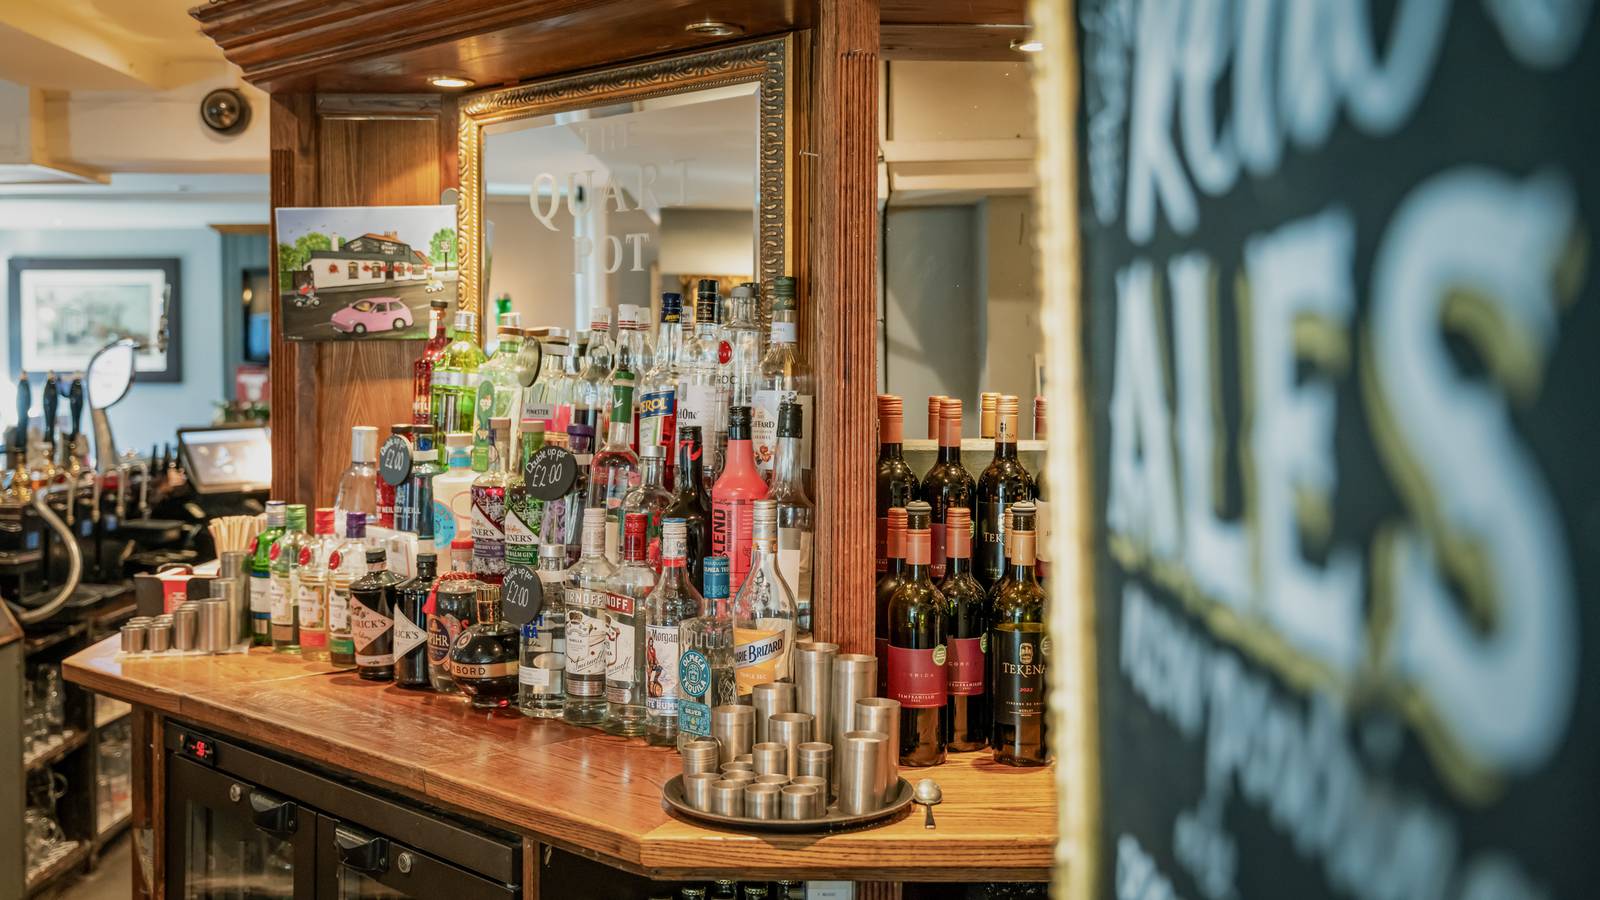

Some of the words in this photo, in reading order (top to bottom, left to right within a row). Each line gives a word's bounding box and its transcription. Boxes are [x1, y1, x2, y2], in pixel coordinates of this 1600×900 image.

[580, 120, 640, 155] THE
[529, 157, 697, 232] QUART
[571, 232, 650, 276] POT
[526, 450, 547, 474] Double
[547, 448, 557, 460] up
[1106, 165, 1580, 778] ALES
[652, 629, 678, 644] Morgan
[682, 654, 706, 671] OLMECA
[748, 638, 783, 664] BRIZARD
[453, 666, 486, 676] BORD
[682, 677, 707, 694] TEQUILA
